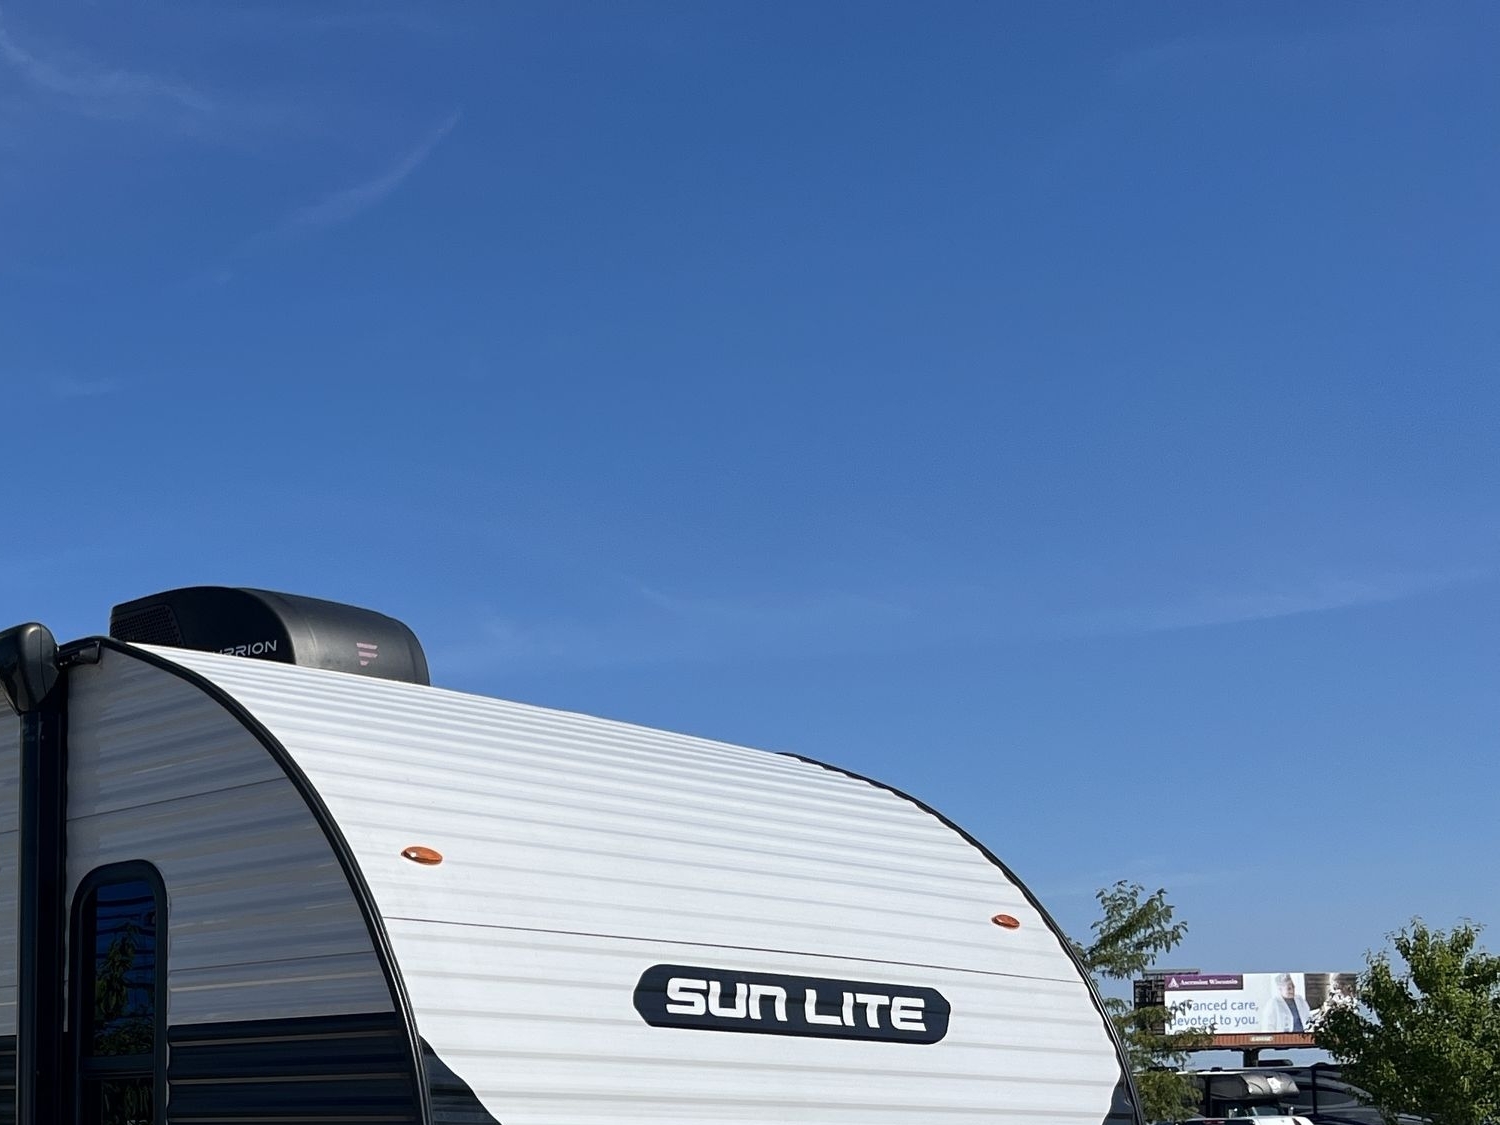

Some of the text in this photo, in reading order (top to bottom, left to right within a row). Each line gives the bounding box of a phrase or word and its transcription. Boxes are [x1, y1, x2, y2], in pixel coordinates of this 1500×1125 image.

[666, 977, 927, 1032] SUN LITE
[1231, 1001, 1259, 1011] care,
[1219, 1015, 1231, 1025] to
[1234, 1015, 1258, 1028] you.
